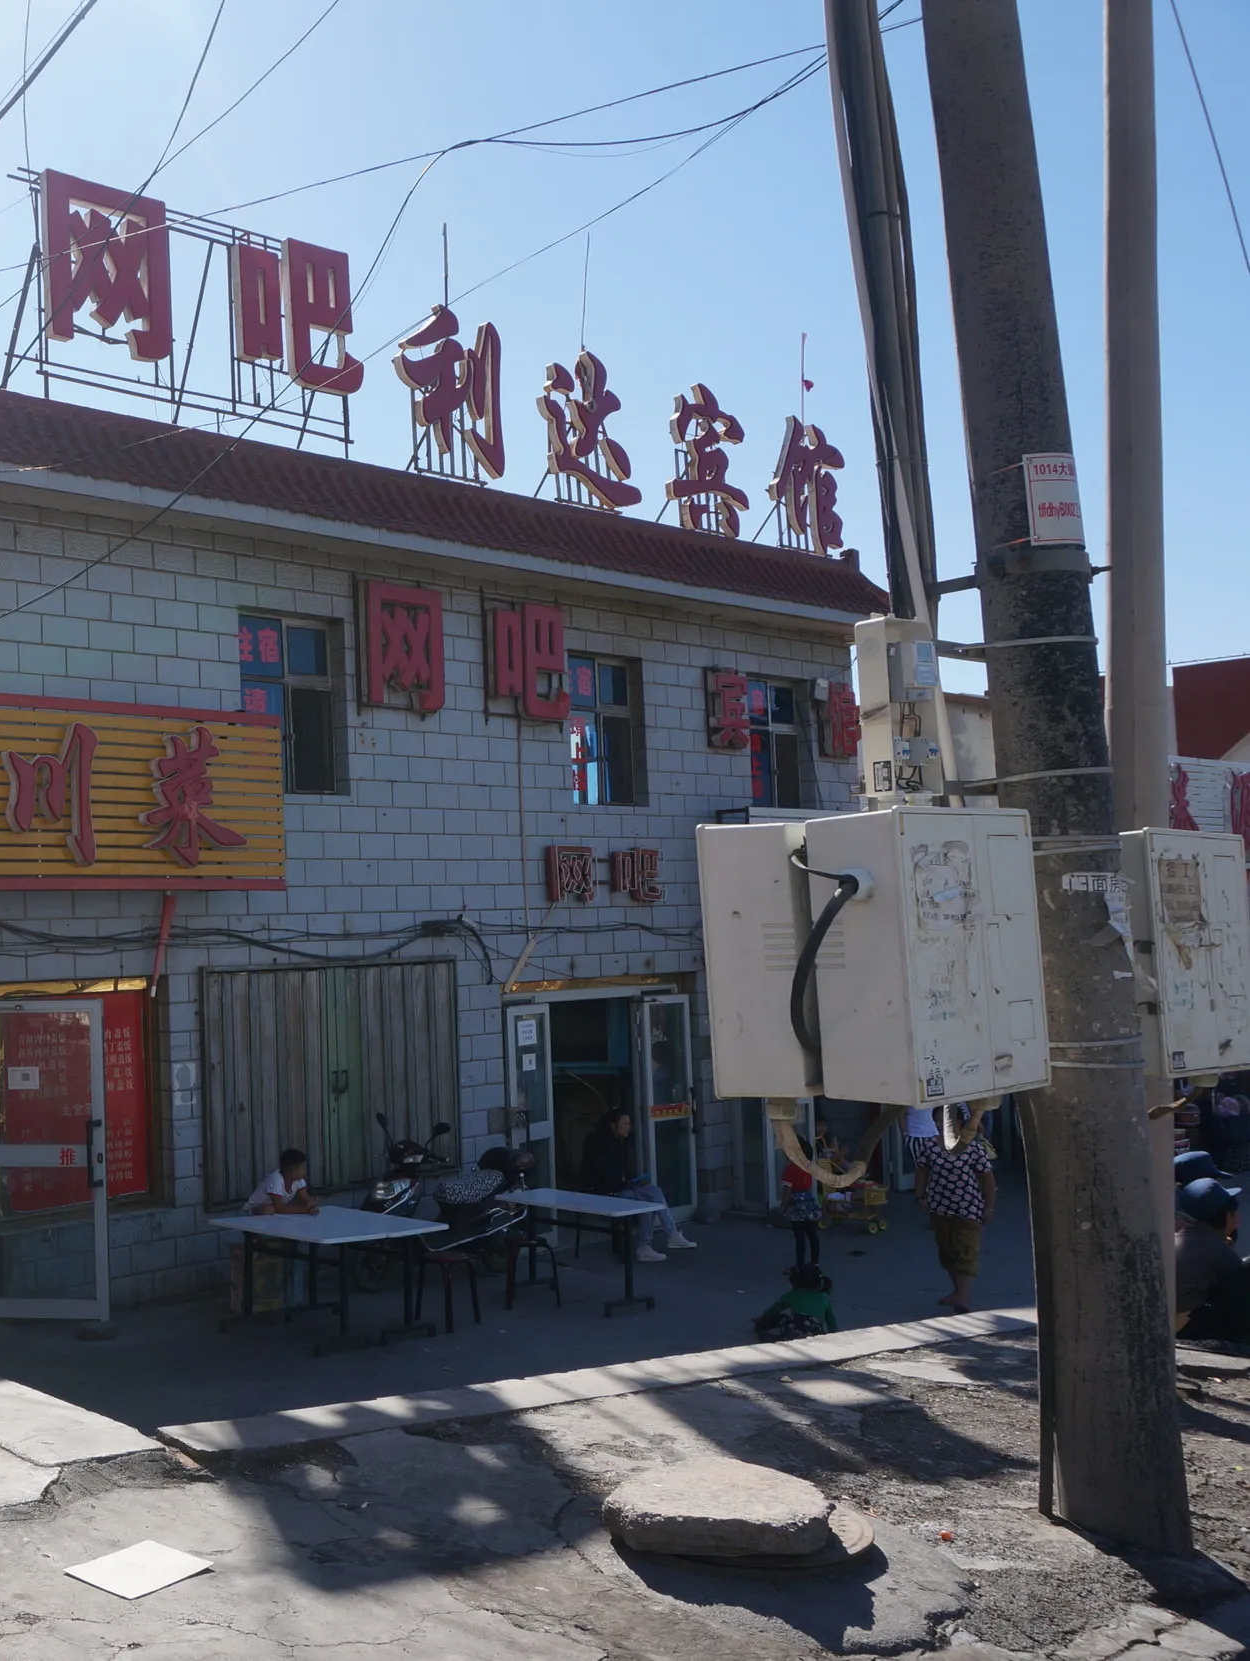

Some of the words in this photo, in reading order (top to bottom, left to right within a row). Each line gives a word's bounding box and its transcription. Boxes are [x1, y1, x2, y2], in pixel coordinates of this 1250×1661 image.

[41, 168, 364, 396] 网吧
[392, 304, 846, 556] 利达宾馆
[362, 580, 571, 721] 网吧
[714, 667, 861, 757] 宾馆
[547, 844, 665, 903] 网吧
[59, 1147, 78, 1166] 推
